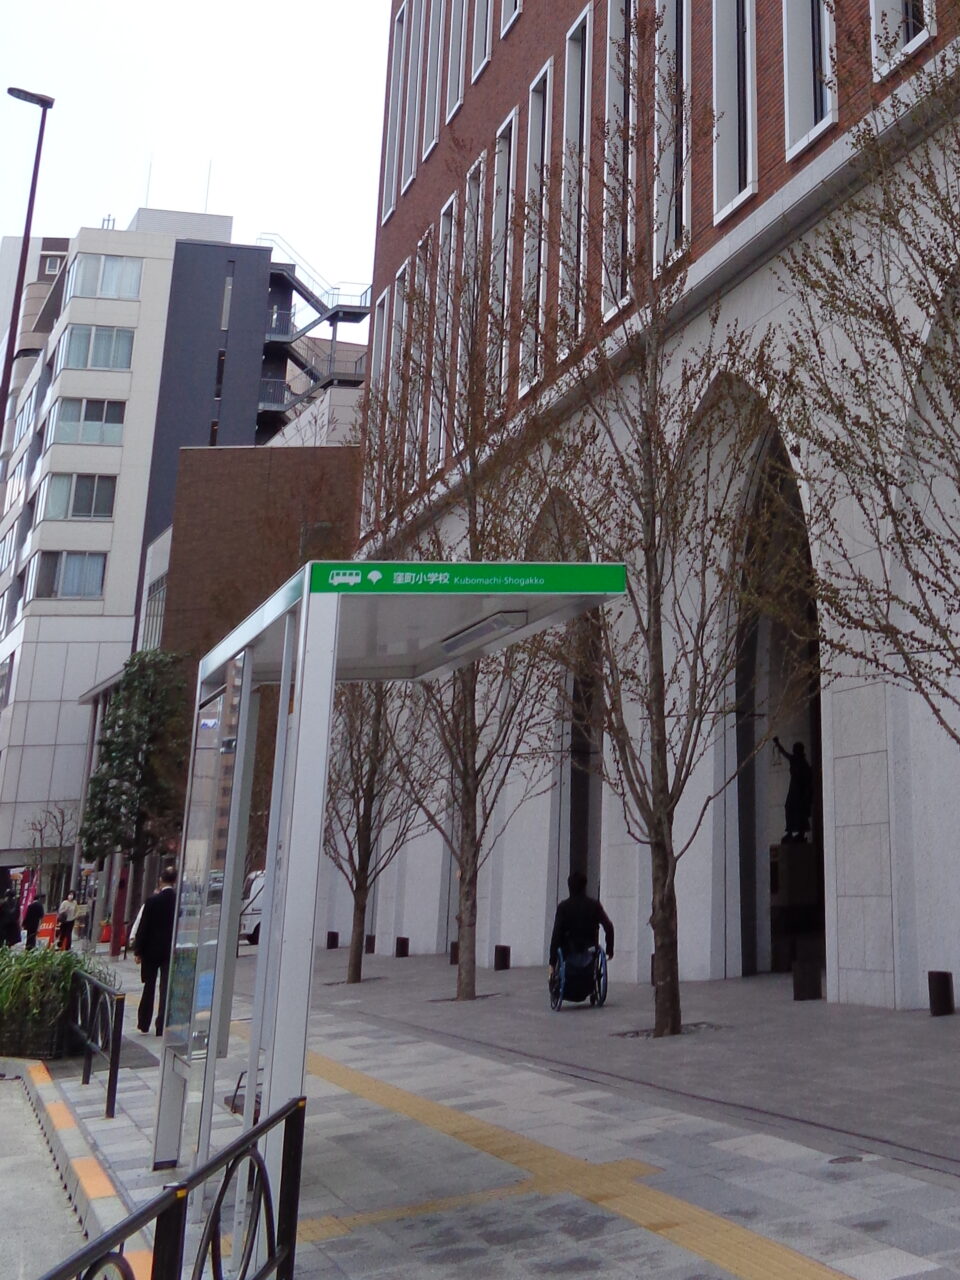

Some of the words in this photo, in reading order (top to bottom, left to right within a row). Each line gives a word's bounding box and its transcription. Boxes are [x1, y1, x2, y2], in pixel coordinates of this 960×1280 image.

[393, 572, 450, 584] 窪町小学校
[454, 576, 545, 586] Kubomachi-Shogakko
